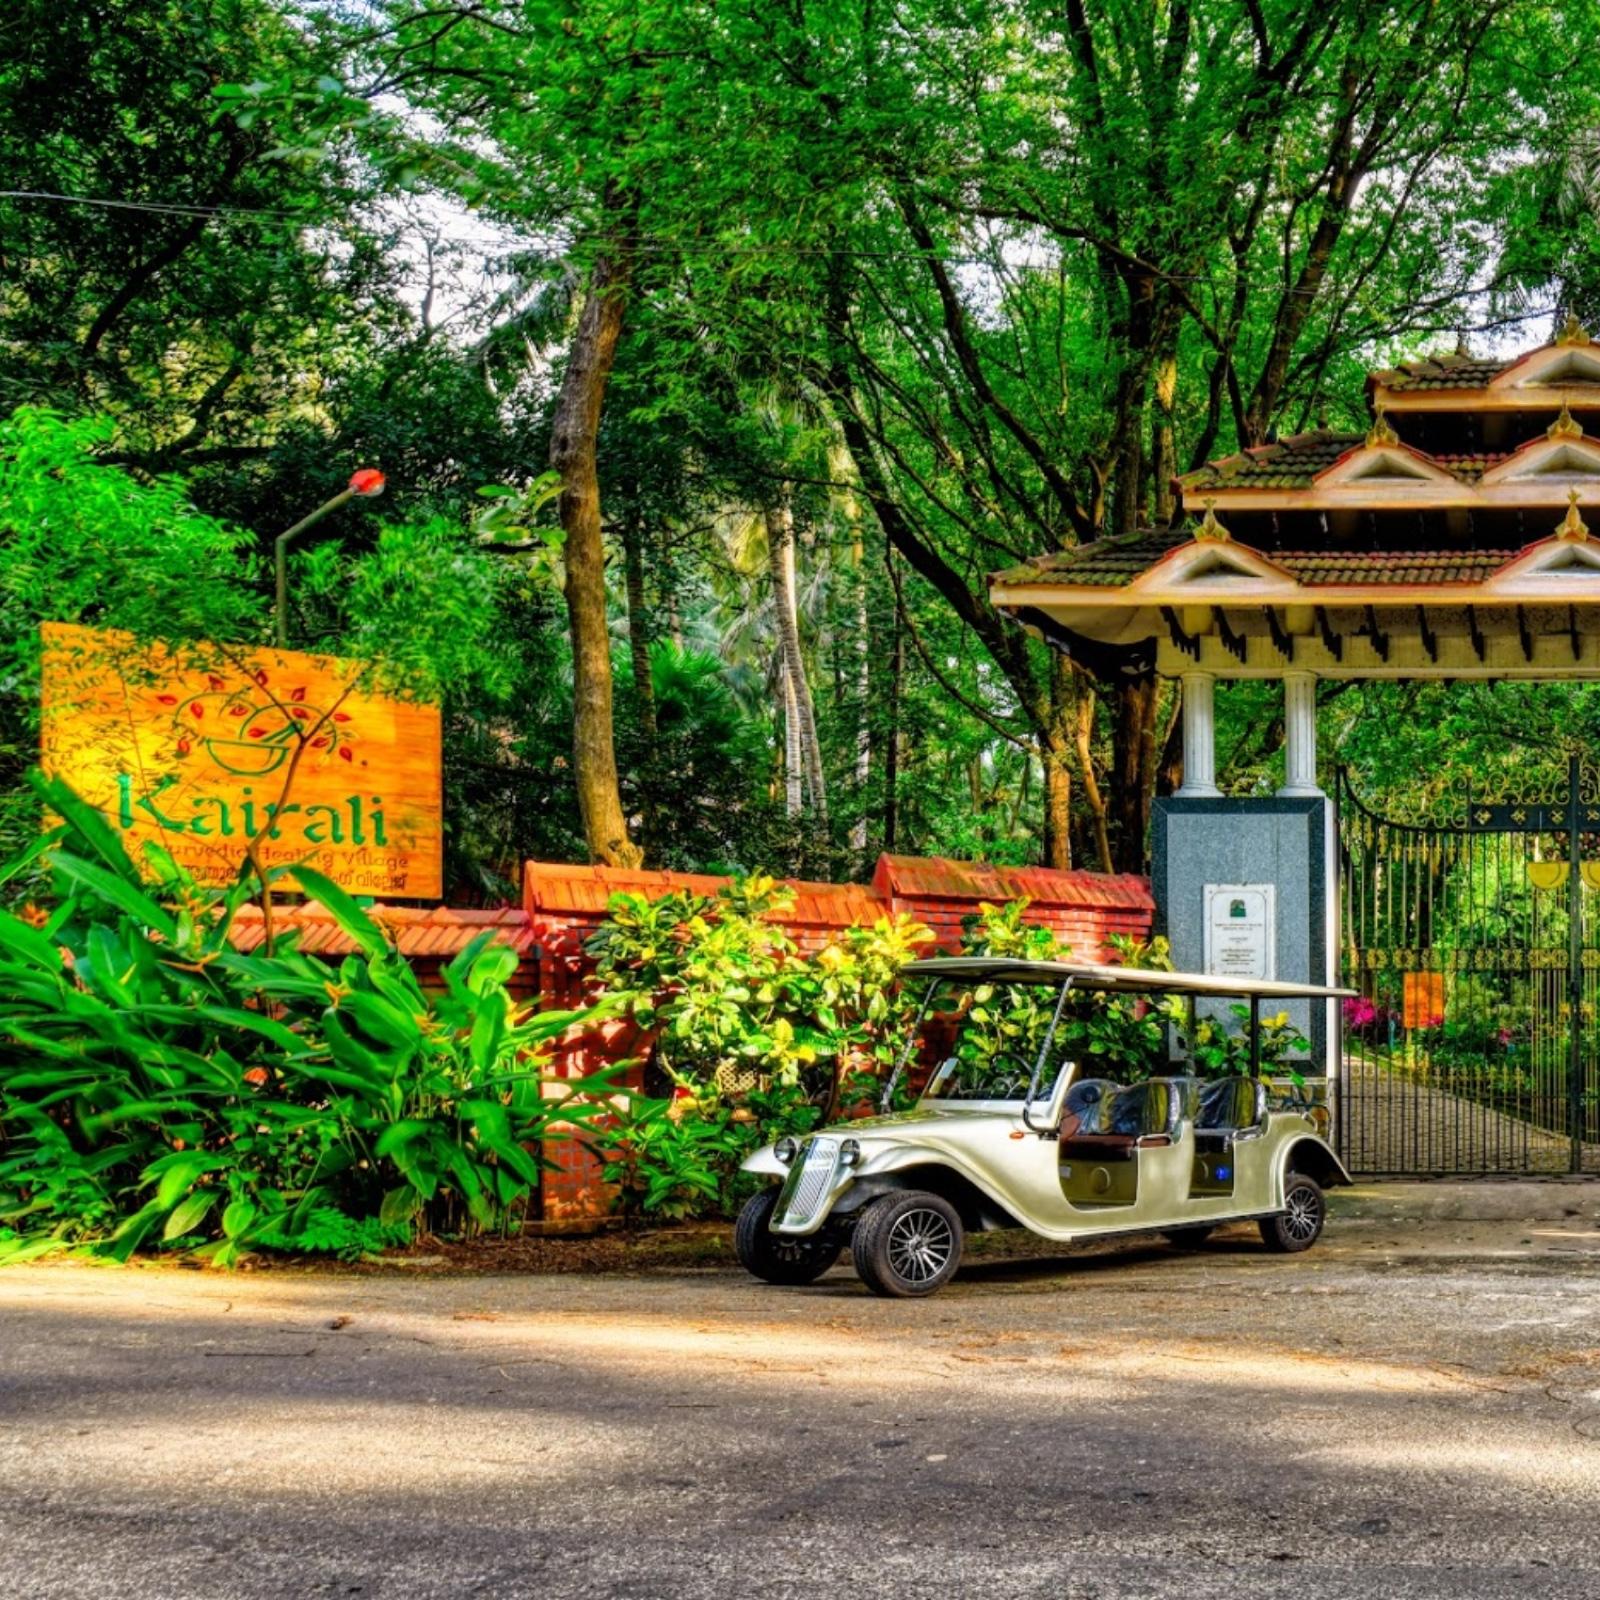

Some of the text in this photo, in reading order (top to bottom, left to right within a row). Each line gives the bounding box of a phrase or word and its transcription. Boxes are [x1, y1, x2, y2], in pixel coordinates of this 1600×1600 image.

[115, 772, 388, 847] Kairali
[146, 842, 248, 858] urvedic
[341, 848, 408, 870] Village
